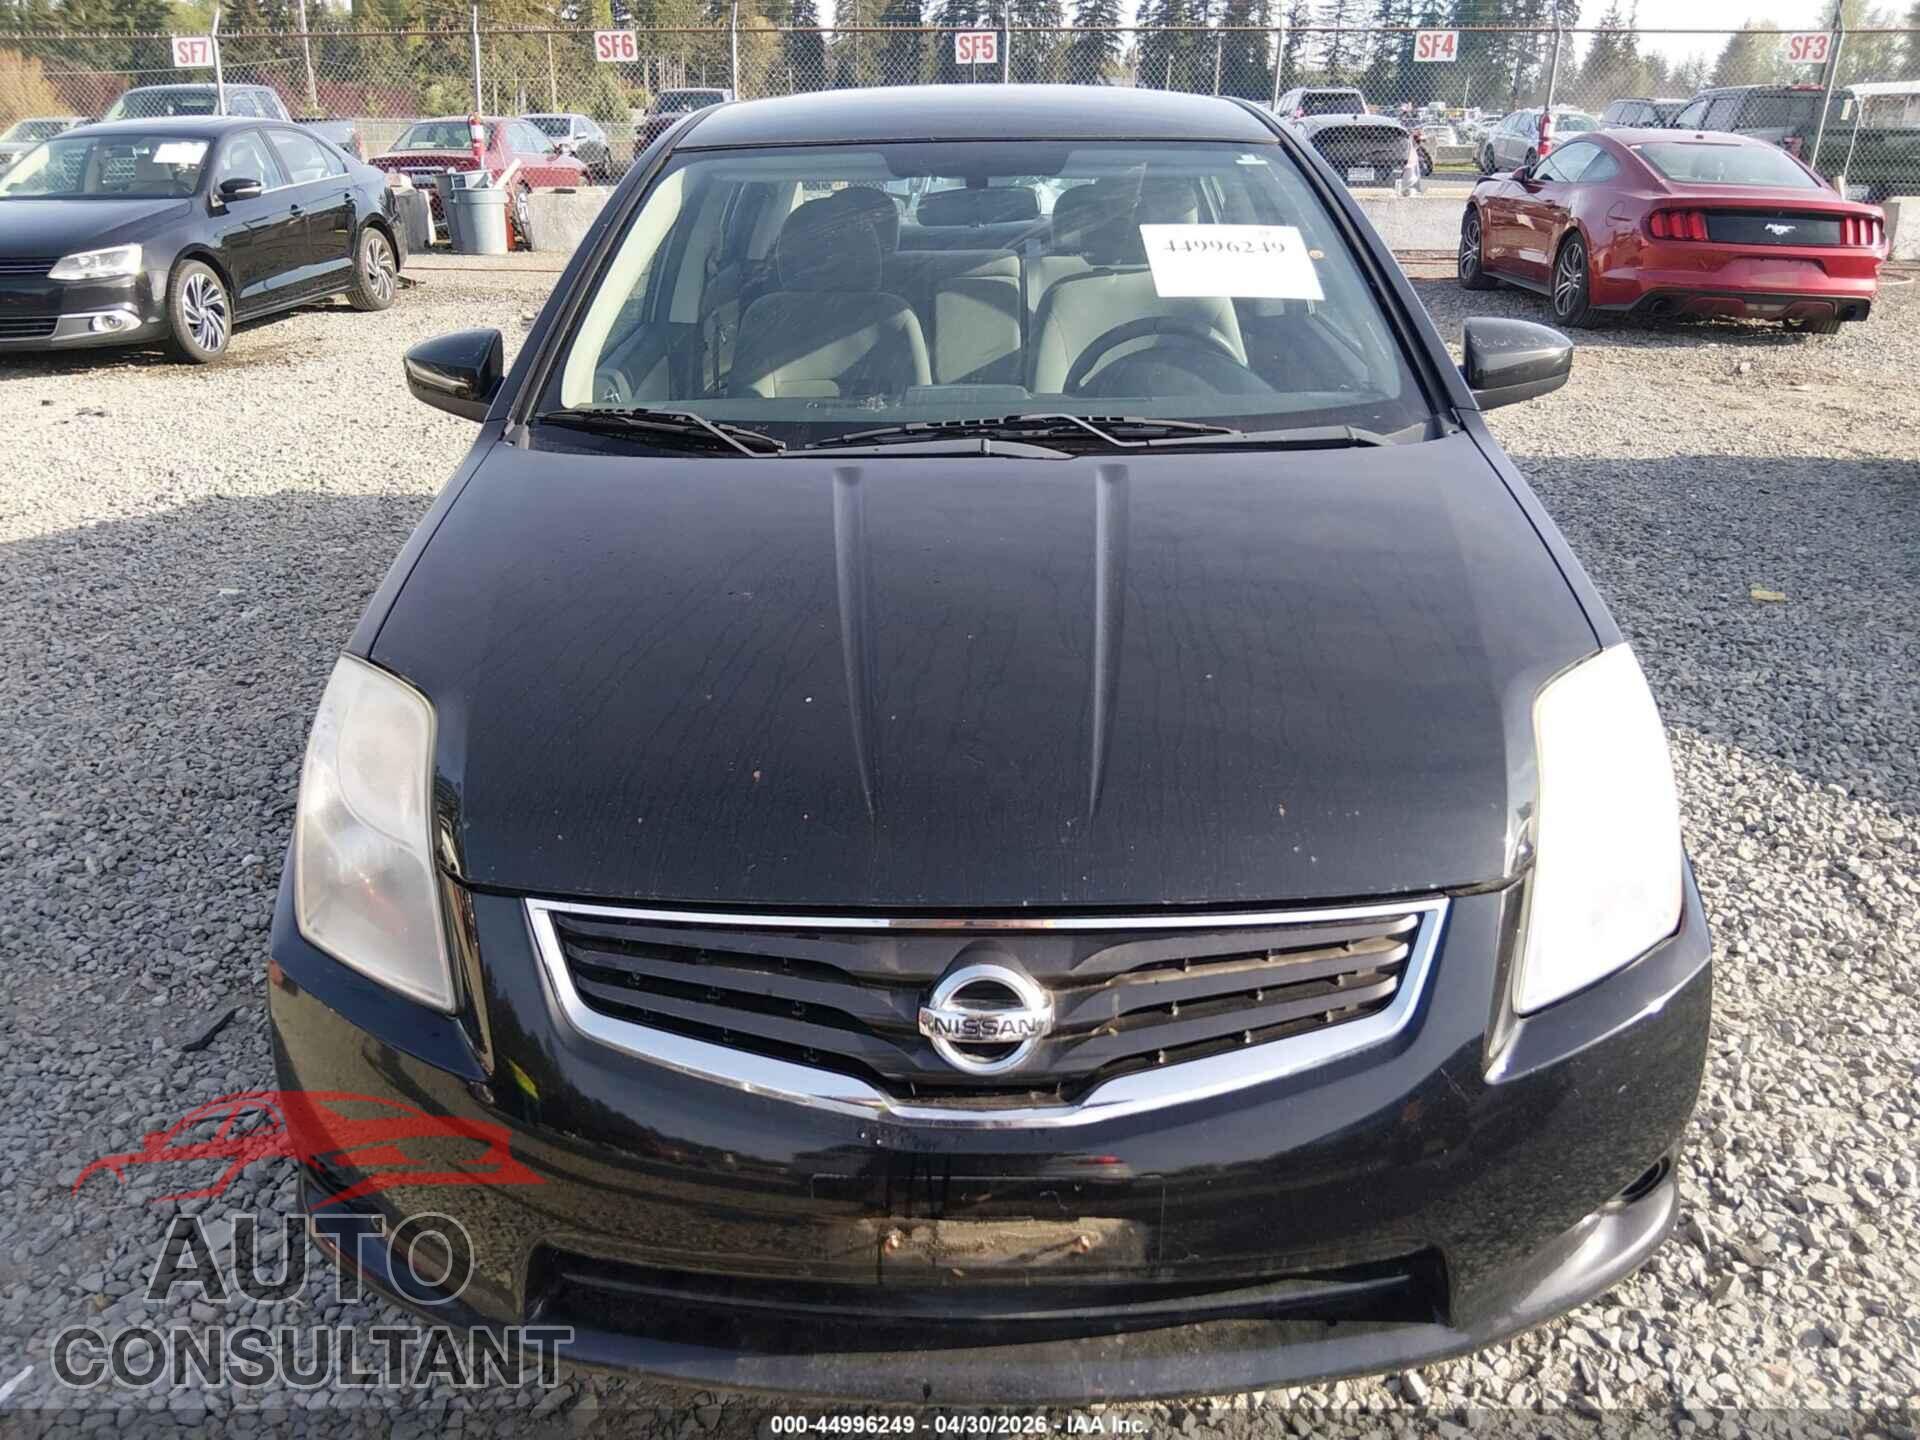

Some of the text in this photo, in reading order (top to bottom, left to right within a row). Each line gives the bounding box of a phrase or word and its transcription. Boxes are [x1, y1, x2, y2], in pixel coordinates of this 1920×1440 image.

[177, 41, 207, 64] SF7
[598, 34, 634, 58] SF6
[959, 35, 993, 59] SF5
[1418, 34, 1454, 58] SF4
[1789, 35, 1828, 60] SF3
[1164, 239, 1287, 254] 44996249
[933, 1016, 1038, 1037] NISSAN
